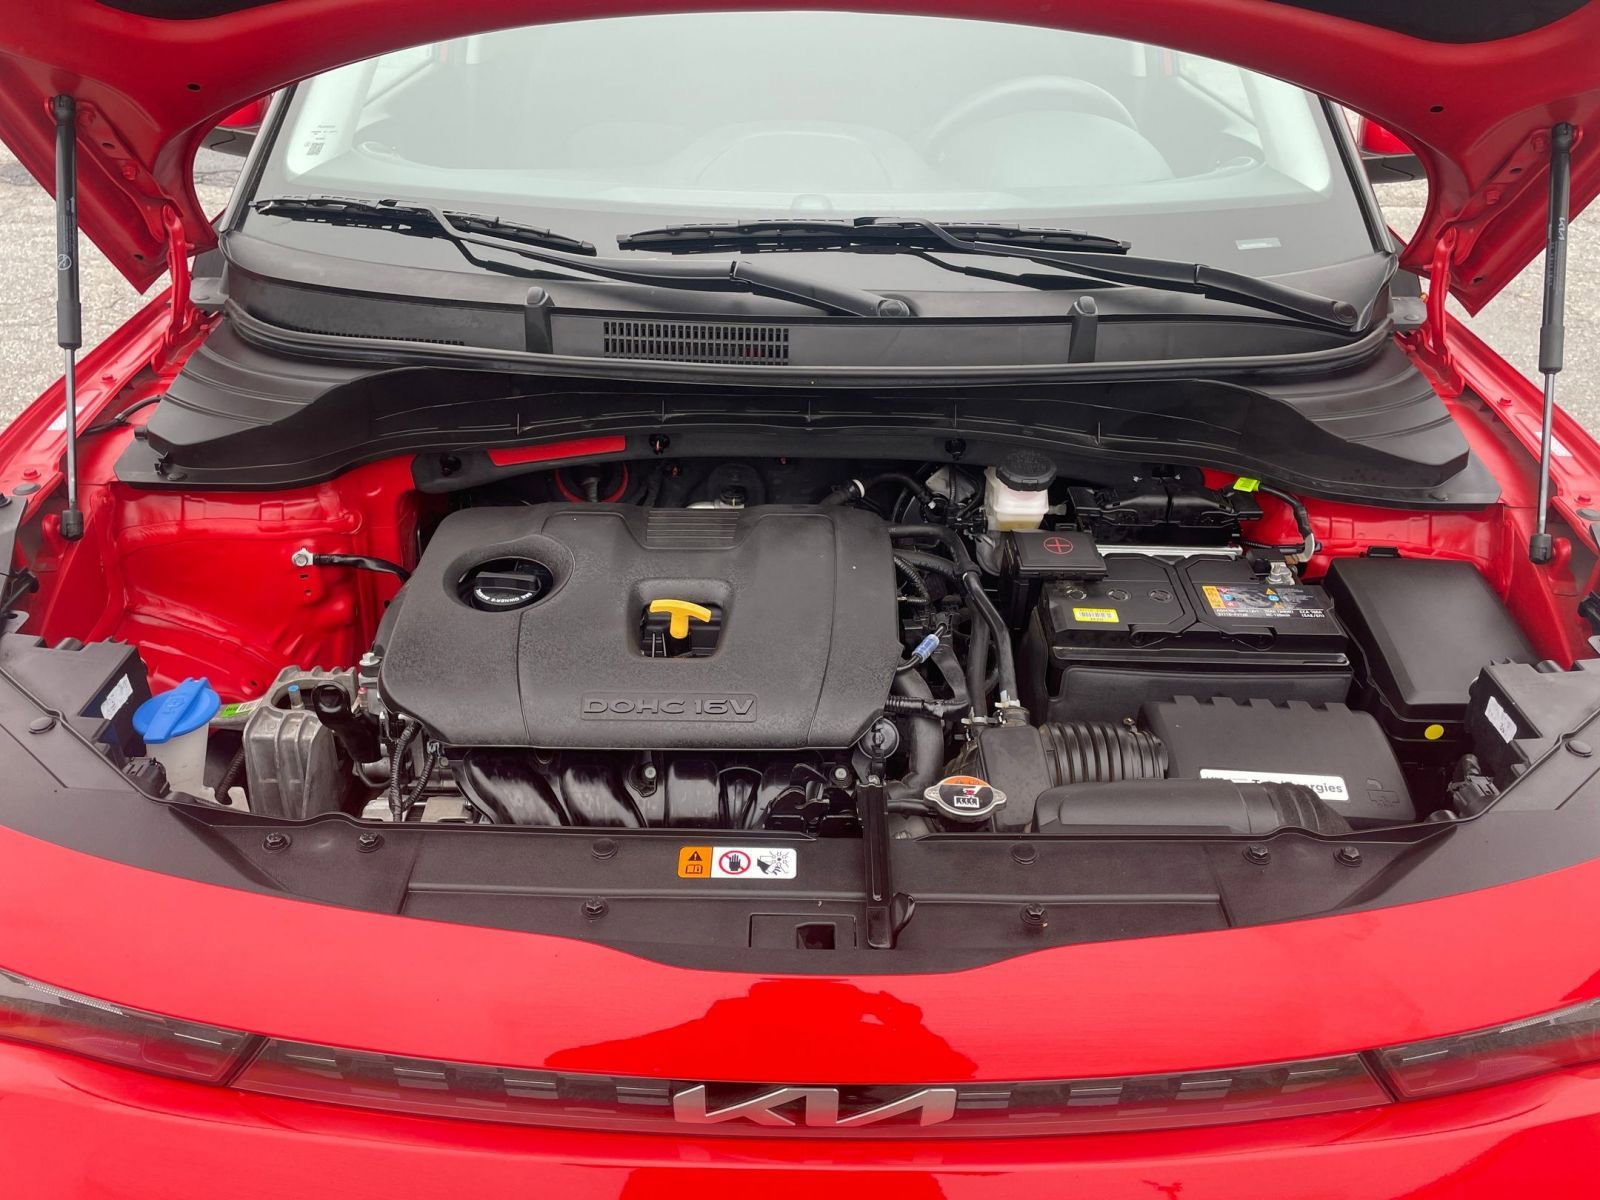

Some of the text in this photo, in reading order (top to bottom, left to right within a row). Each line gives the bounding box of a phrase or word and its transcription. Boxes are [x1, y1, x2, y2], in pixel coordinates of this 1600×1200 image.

[583, 699, 755, 716] DOHC 16V
[672, 1084, 957, 1128] KIA
